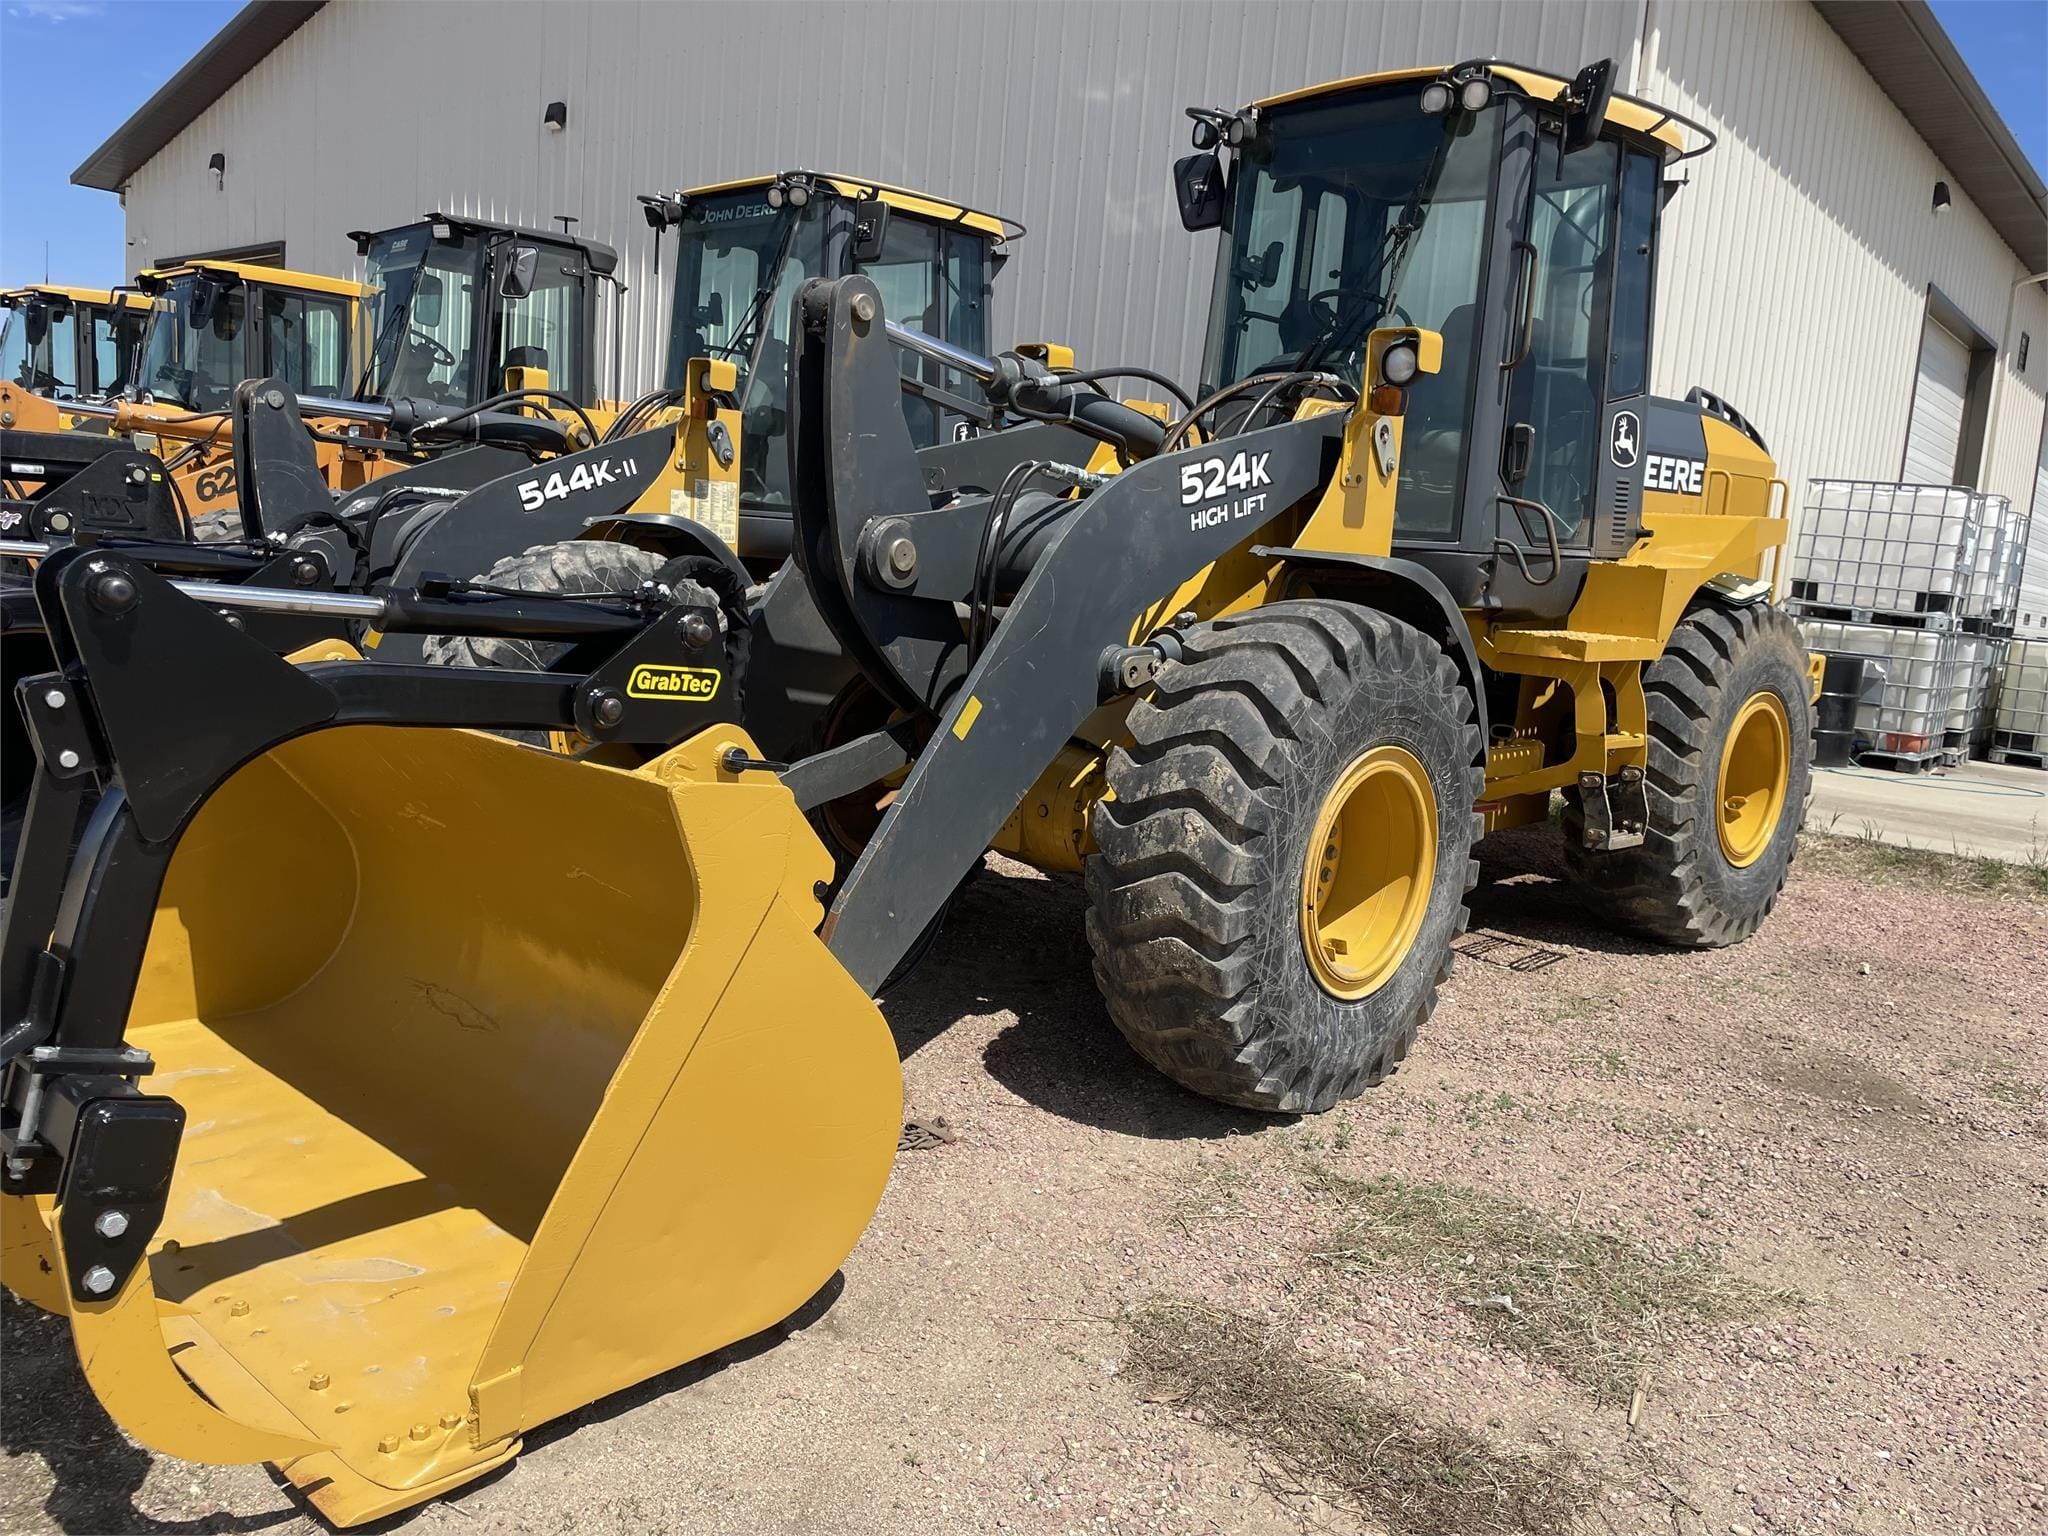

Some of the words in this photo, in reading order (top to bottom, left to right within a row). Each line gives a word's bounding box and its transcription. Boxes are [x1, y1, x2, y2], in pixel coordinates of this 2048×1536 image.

[700, 207, 734, 224] JOHN
[196, 466, 237, 502] 62
[1180, 450, 1273, 505] 524K
[1643, 454, 1705, 493] EERE
[1190, 504, 1228, 532] HIGH
[1234, 493, 1267, 519] LIFT
[636, 670, 712, 694] GrabTec
